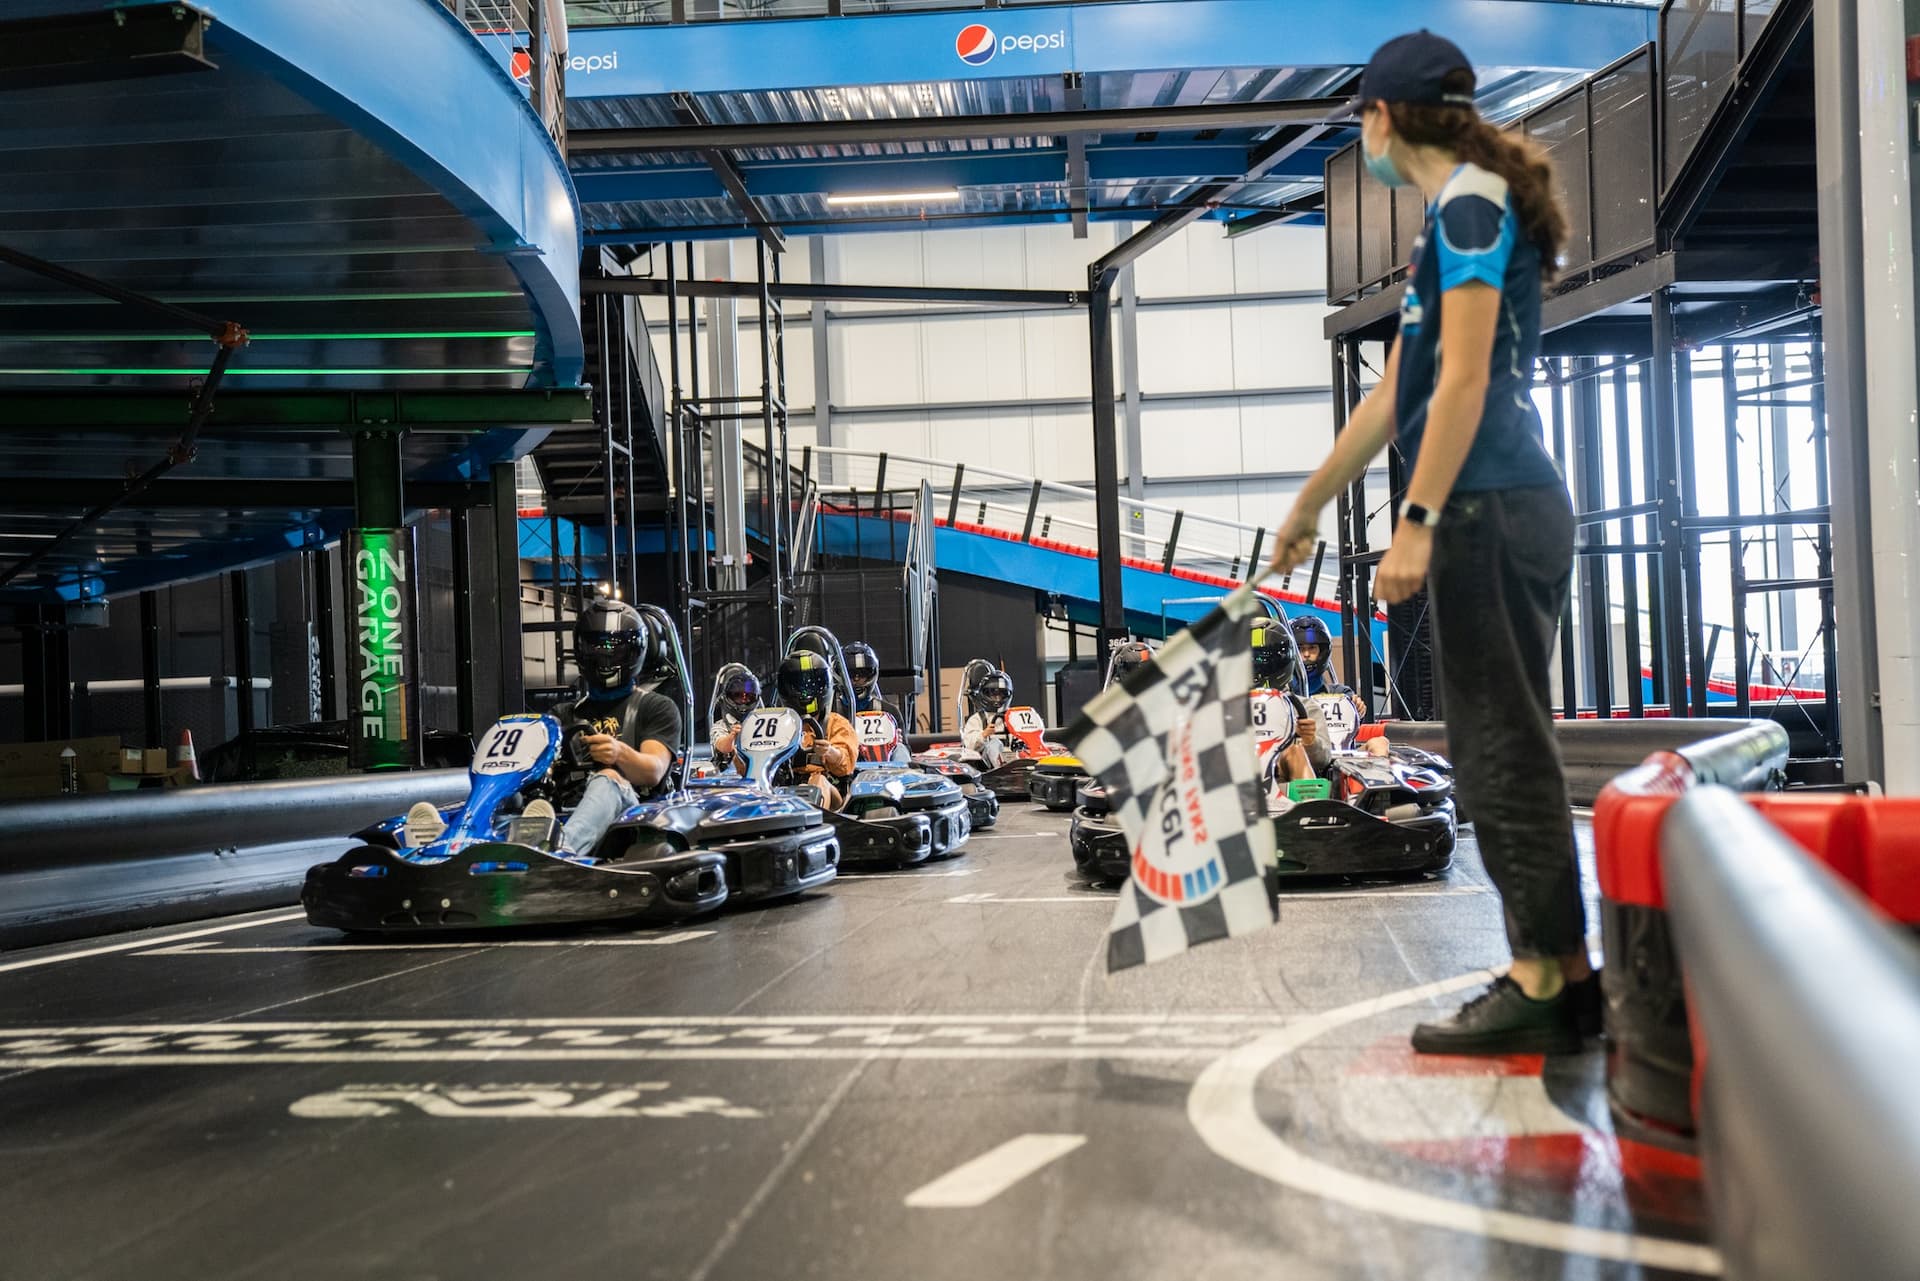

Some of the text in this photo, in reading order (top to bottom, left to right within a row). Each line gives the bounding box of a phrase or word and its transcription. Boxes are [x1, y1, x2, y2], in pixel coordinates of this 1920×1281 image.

[1001, 29, 1065, 55] pepsi
[379, 549, 406, 676] ZONE
[356, 550, 384, 739] GARAGE
[1019, 712, 1033, 725] 12
[1321, 702, 1343, 721] 24
[752, 717, 778, 739] 26
[863, 719, 883, 735] 22
[486, 729, 523, 758] 29
[749, 740, 780, 748] FAST
[481, 760, 521, 769] FAST
